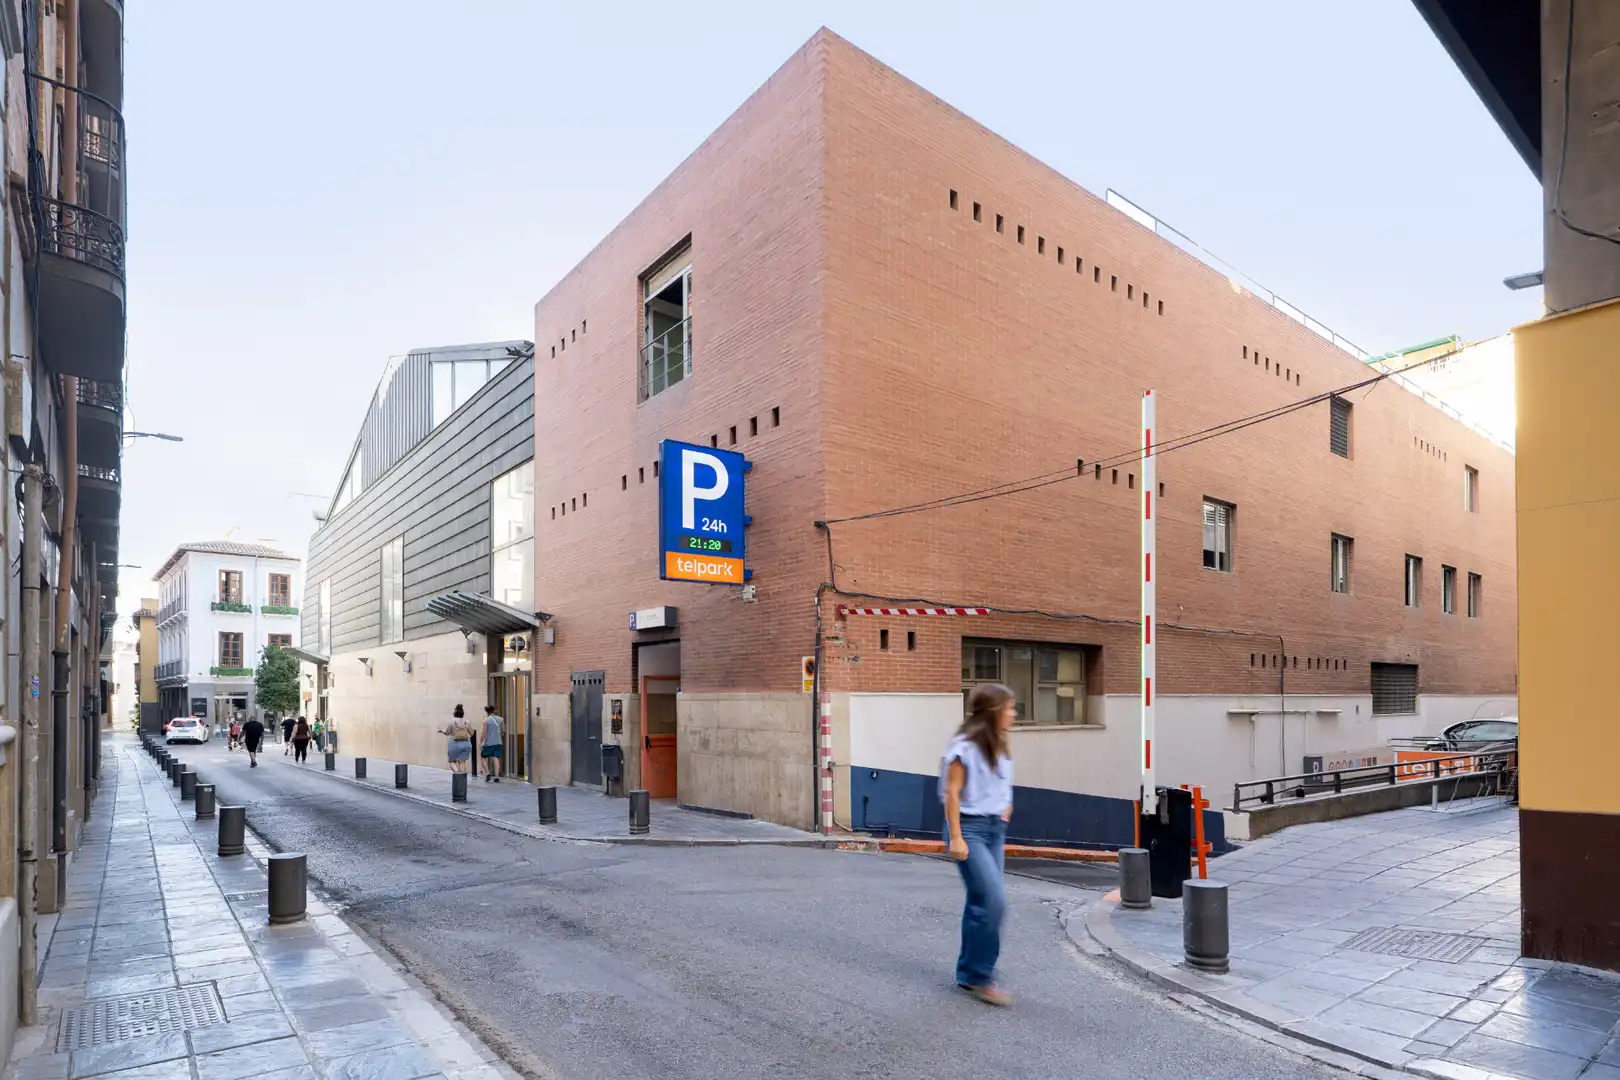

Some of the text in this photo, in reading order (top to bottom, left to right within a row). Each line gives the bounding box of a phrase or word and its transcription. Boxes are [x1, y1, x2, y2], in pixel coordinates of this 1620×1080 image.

[682, 449, 729, 529] P
[702, 517, 727, 533] 24h
[690, 537, 721, 550] 21:20
[677, 557, 733, 577] telpark
